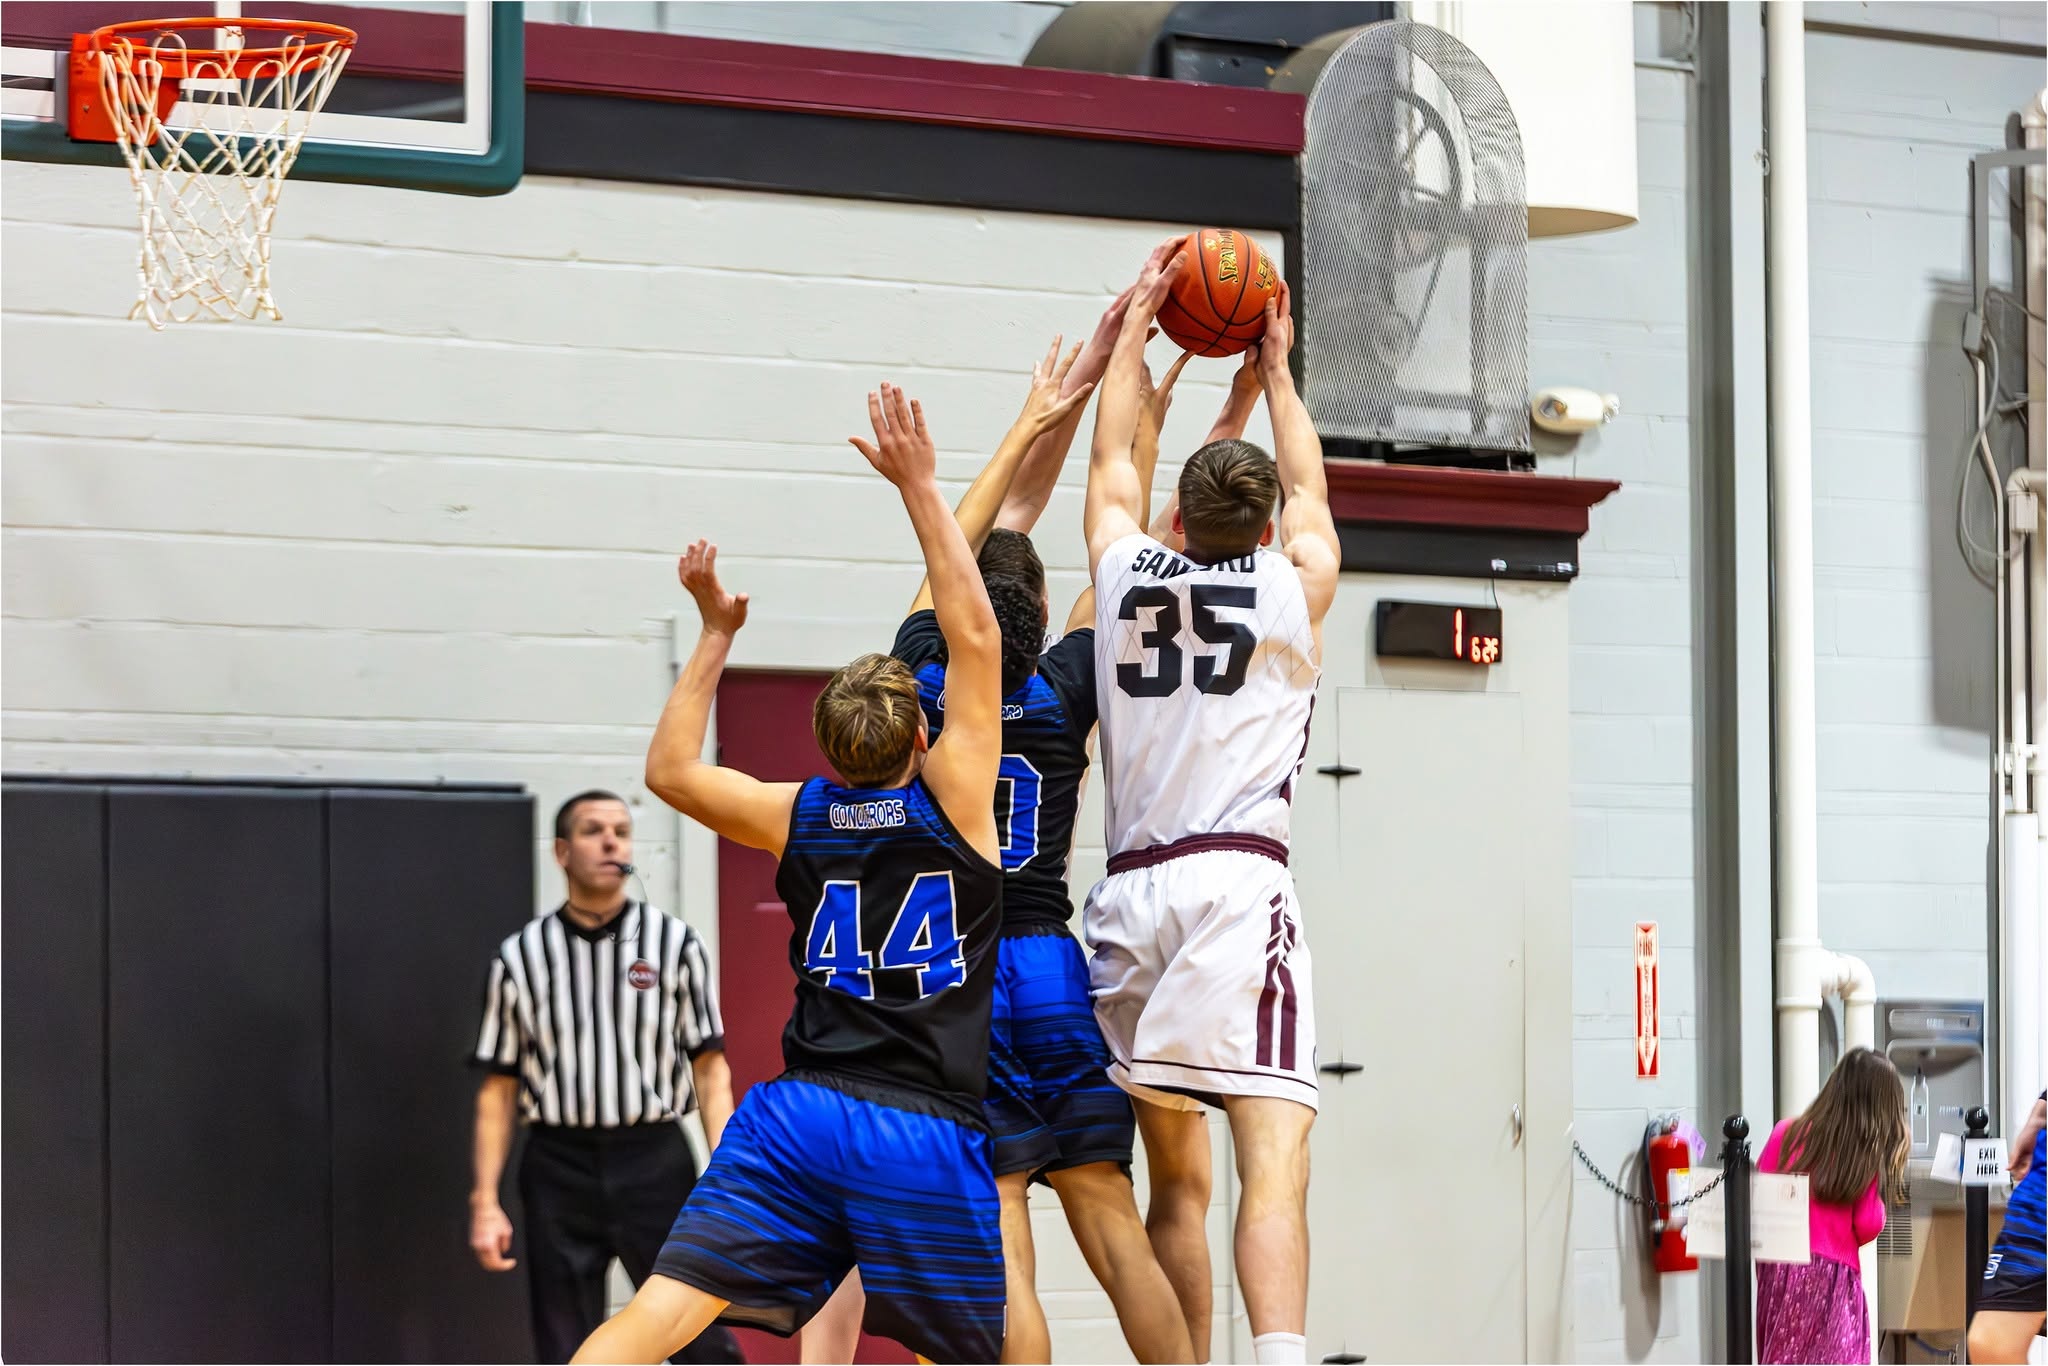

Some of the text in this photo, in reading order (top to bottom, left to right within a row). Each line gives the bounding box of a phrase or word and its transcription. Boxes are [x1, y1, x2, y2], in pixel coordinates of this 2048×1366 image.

[1116, 584, 1258, 698] 35
[803, 869, 968, 1001] 44
[1976, 1162, 1999, 1177] HERE
[1978, 1146, 1997, 1161] EXIT
